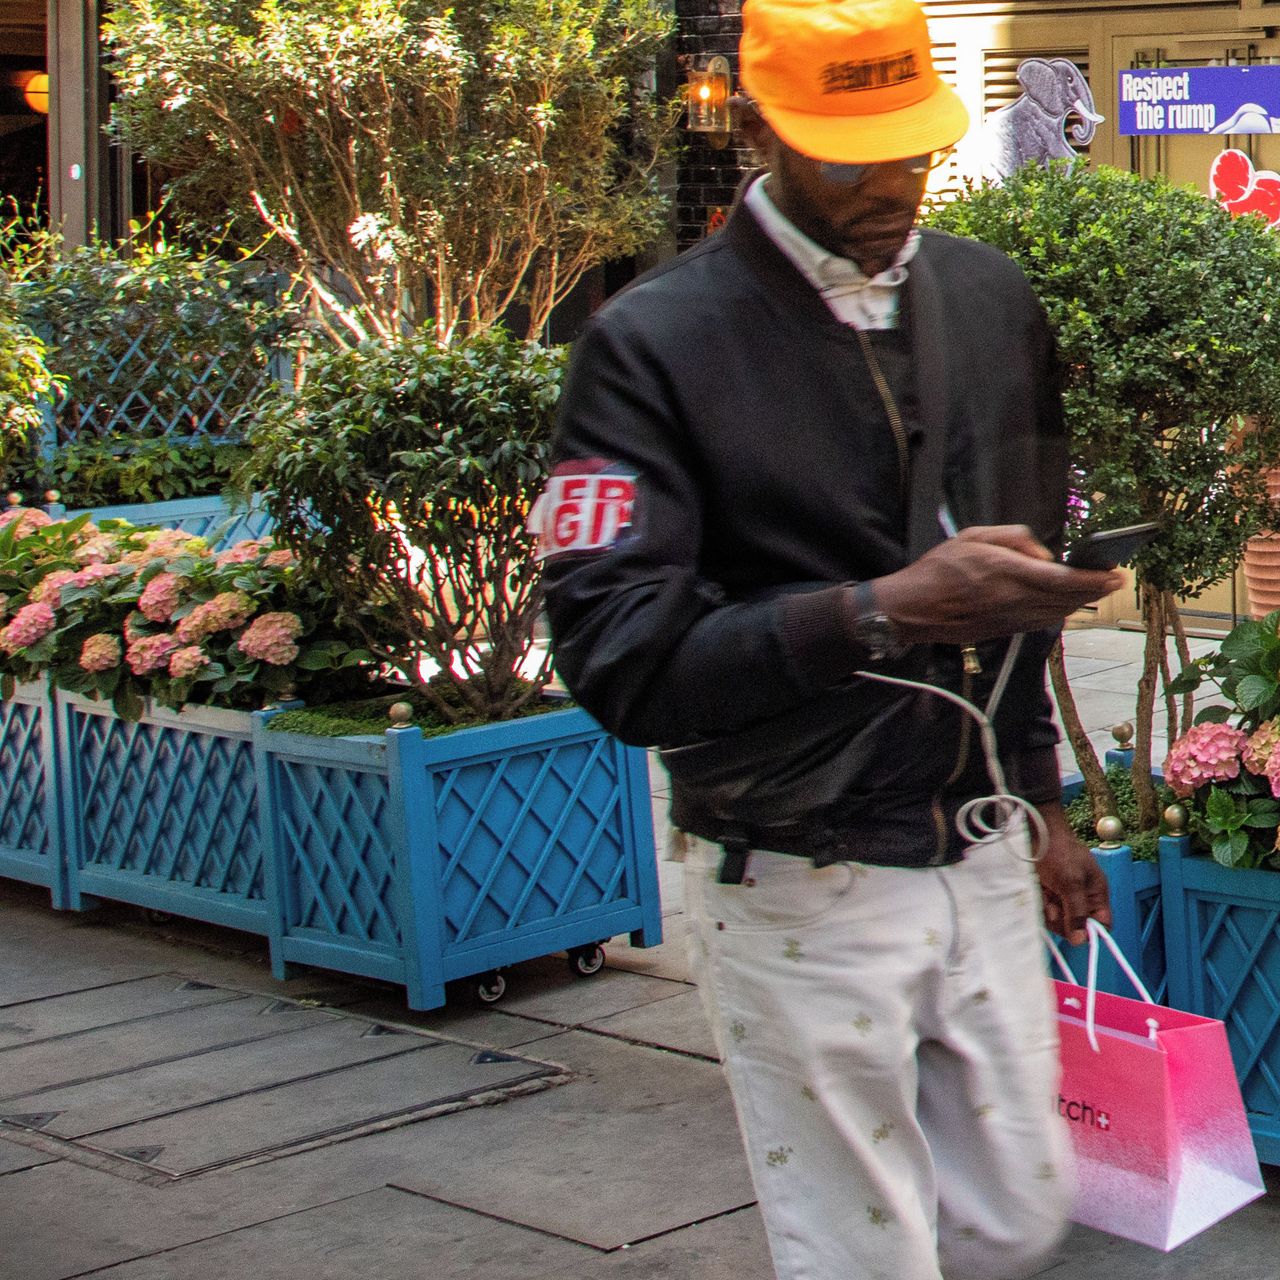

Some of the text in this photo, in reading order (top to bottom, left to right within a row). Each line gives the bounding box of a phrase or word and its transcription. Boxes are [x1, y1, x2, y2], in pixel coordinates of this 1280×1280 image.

[1122, 72, 1190, 104] Respect
[1136, 102, 1215, 132] the rump
